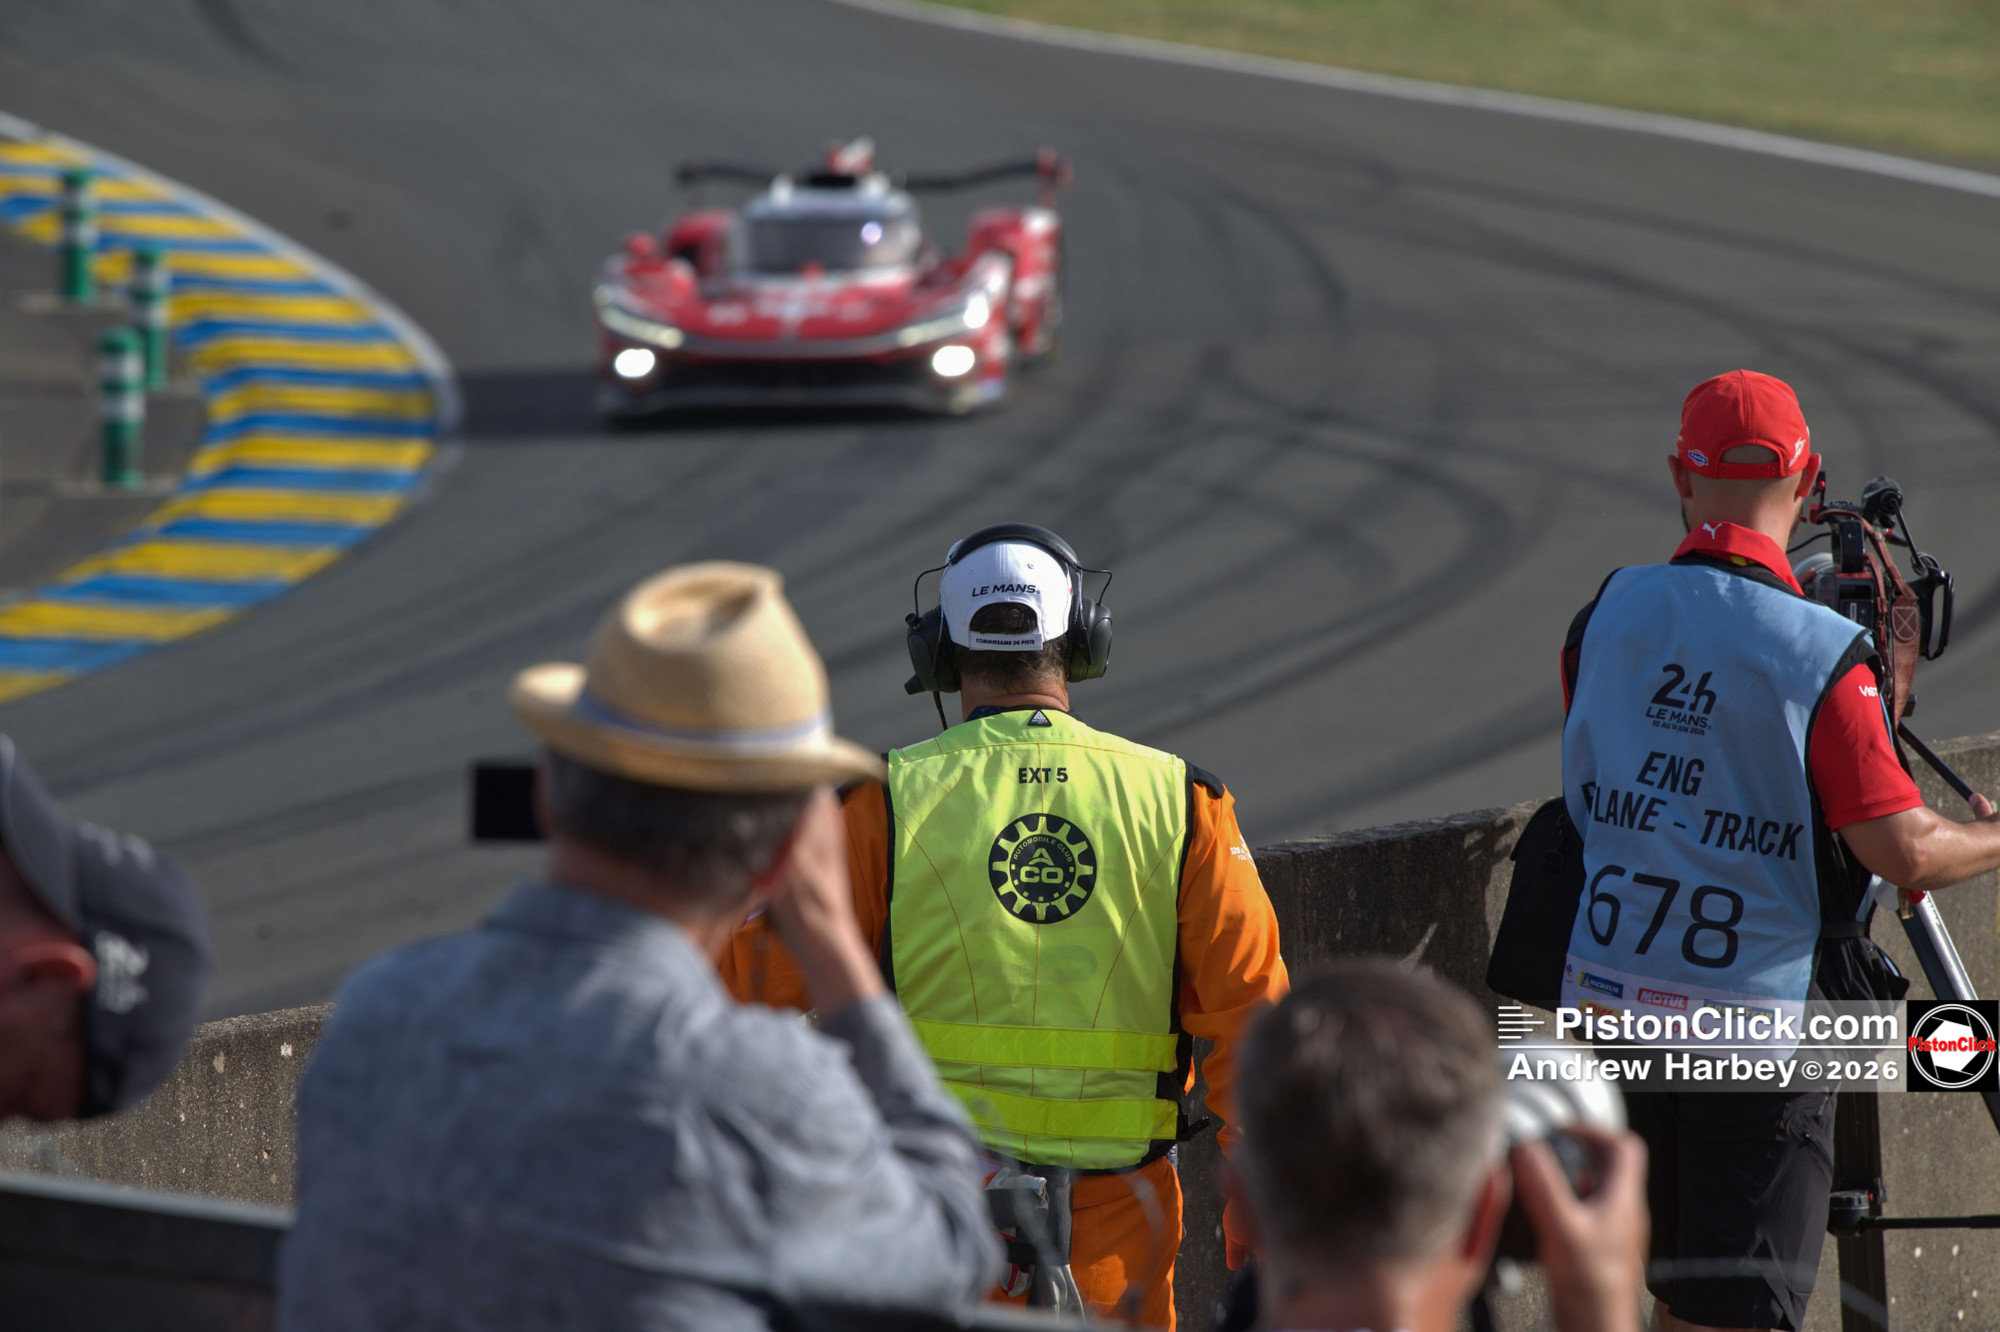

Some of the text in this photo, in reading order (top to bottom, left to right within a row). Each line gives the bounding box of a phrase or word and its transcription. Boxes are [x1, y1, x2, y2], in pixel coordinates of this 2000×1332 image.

[972, 584, 1036, 597] LE MANS
[1645, 706, 1709, 728] LE MANS
[1018, 767, 1068, 784] EXT 5
[1636, 751, 1705, 796] ENG
[1700, 809, 1804, 860] TRACK
[1013, 836, 1072, 862] AUTOMOBILE CLUB
[1587, 864, 1744, 969] 678
[1641, 991, 1686, 1009] MOTUL
